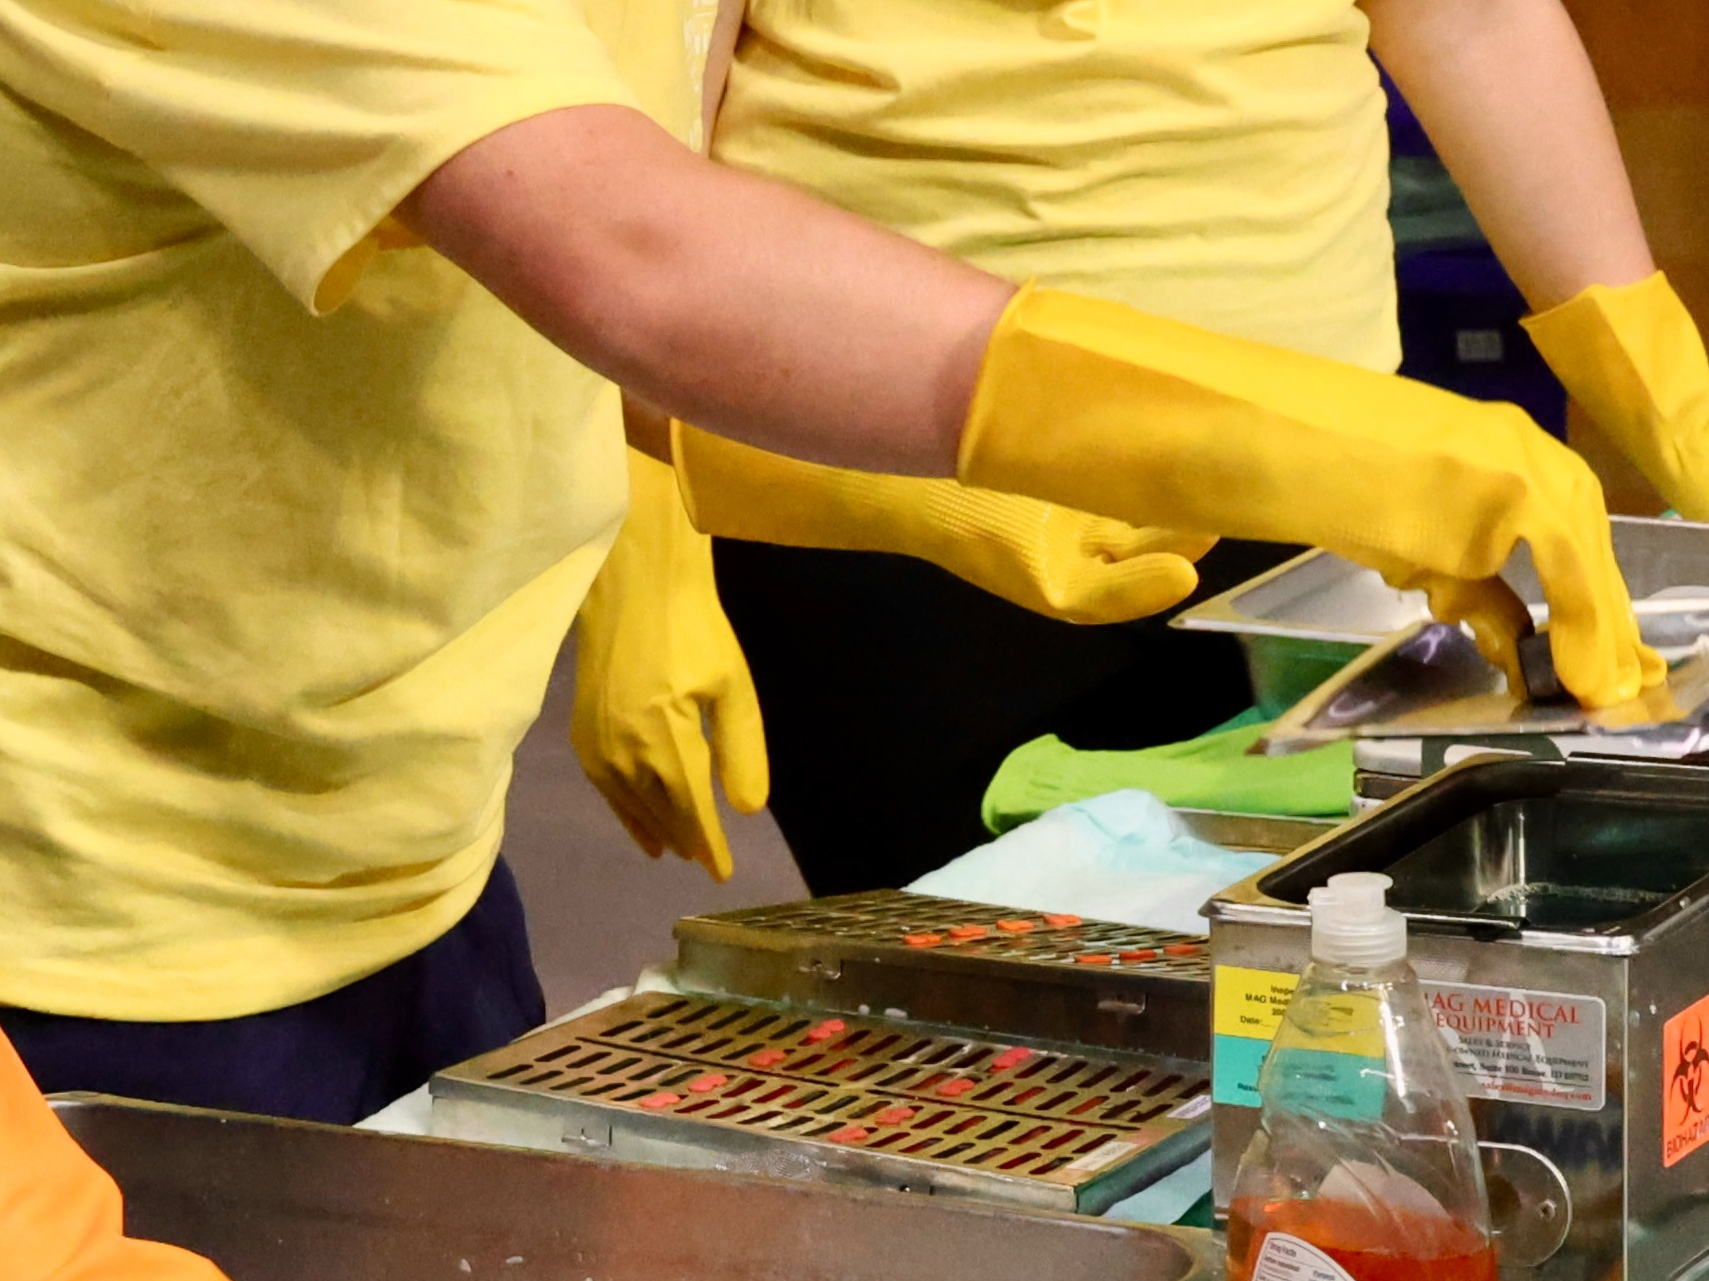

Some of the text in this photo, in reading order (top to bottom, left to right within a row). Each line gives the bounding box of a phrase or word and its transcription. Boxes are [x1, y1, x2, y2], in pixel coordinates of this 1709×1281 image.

[1424, 991, 1581, 1025] AG MEDICAL
[1435, 1012, 1556, 1039] EQUIPMENT
